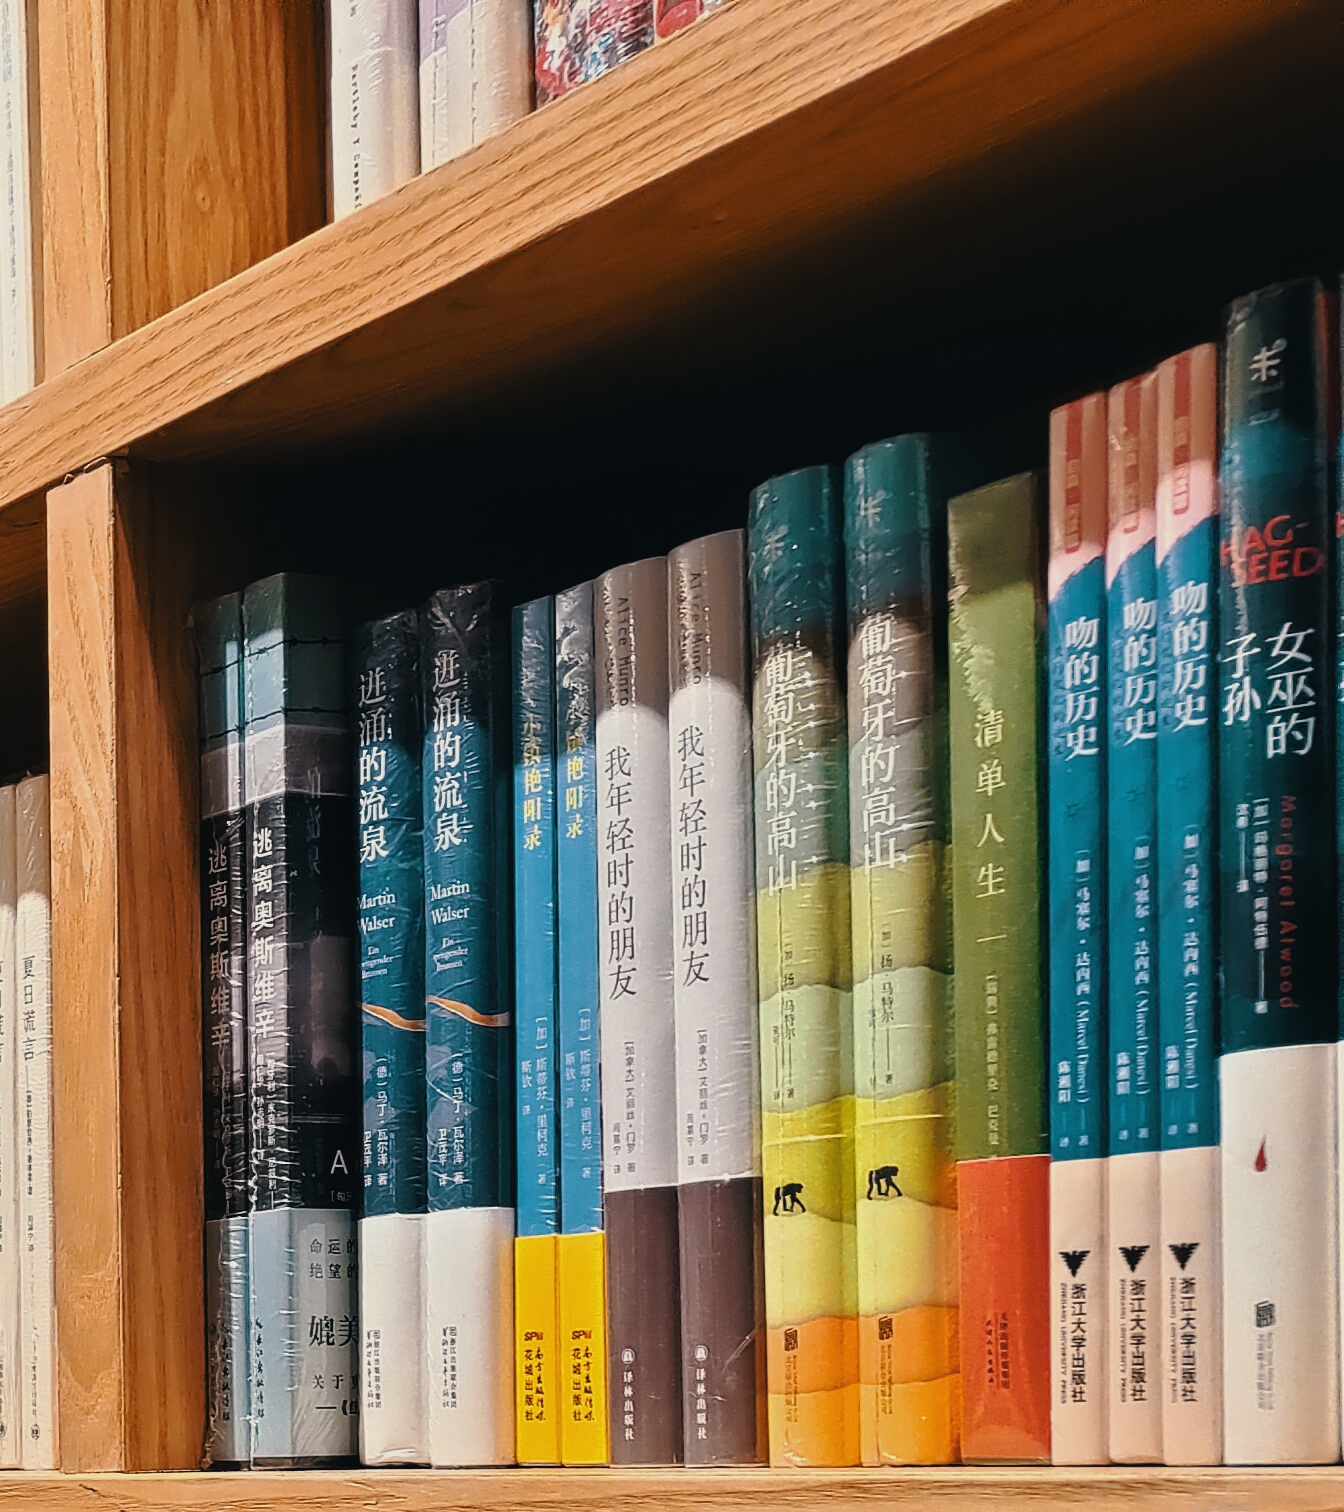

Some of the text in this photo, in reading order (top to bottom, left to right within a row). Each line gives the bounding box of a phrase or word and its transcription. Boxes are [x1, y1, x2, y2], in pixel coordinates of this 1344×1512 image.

[1228, 546, 1326, 589] SEED
[617, 596, 630, 707] Alice Munro
[1064, 614, 1100, 762] 吻的历史
[1122, 596, 1158, 746] 吻的历史
[1170, 580, 1209, 733] 吻的历史
[1221, 632, 1263, 728] 子孙
[1265, 622, 1316, 759] 女巫的
[763, 644, 798, 898] 葡萄牙的高山
[859, 611, 899, 875] 葡萄牙的高山
[973, 710, 1007, 900] 清单人生
[429, 880, 470, 902] Martin
[430, 906, 470, 925] Walser
[604, 745, 637, 1001] 我年轻时的朋友
[677, 725, 710, 987] 我年轻时的朋友
[208, 846, 231, 1050] 逃离奥斯维辛
[252, 826, 277, 1040] 逃离奥斯维辛
[21, 954, 37, 1063] 夏日谎言
[330, 1149, 349, 1175] A
[524, 1348, 535, 1422] 花城出版社
[571, 1347, 583, 1422] 花城出版社
[1070, 1282, 1087, 1404] 浙江大学出版社
[1129, 1278, 1147, 1403] 浙江大学出版社
[1180, 1276, 1199, 1403] 浙江大学出版社
[622, 1369, 635, 1441] 译林出版社
[695, 1367, 708, 1440] 译林出版社
